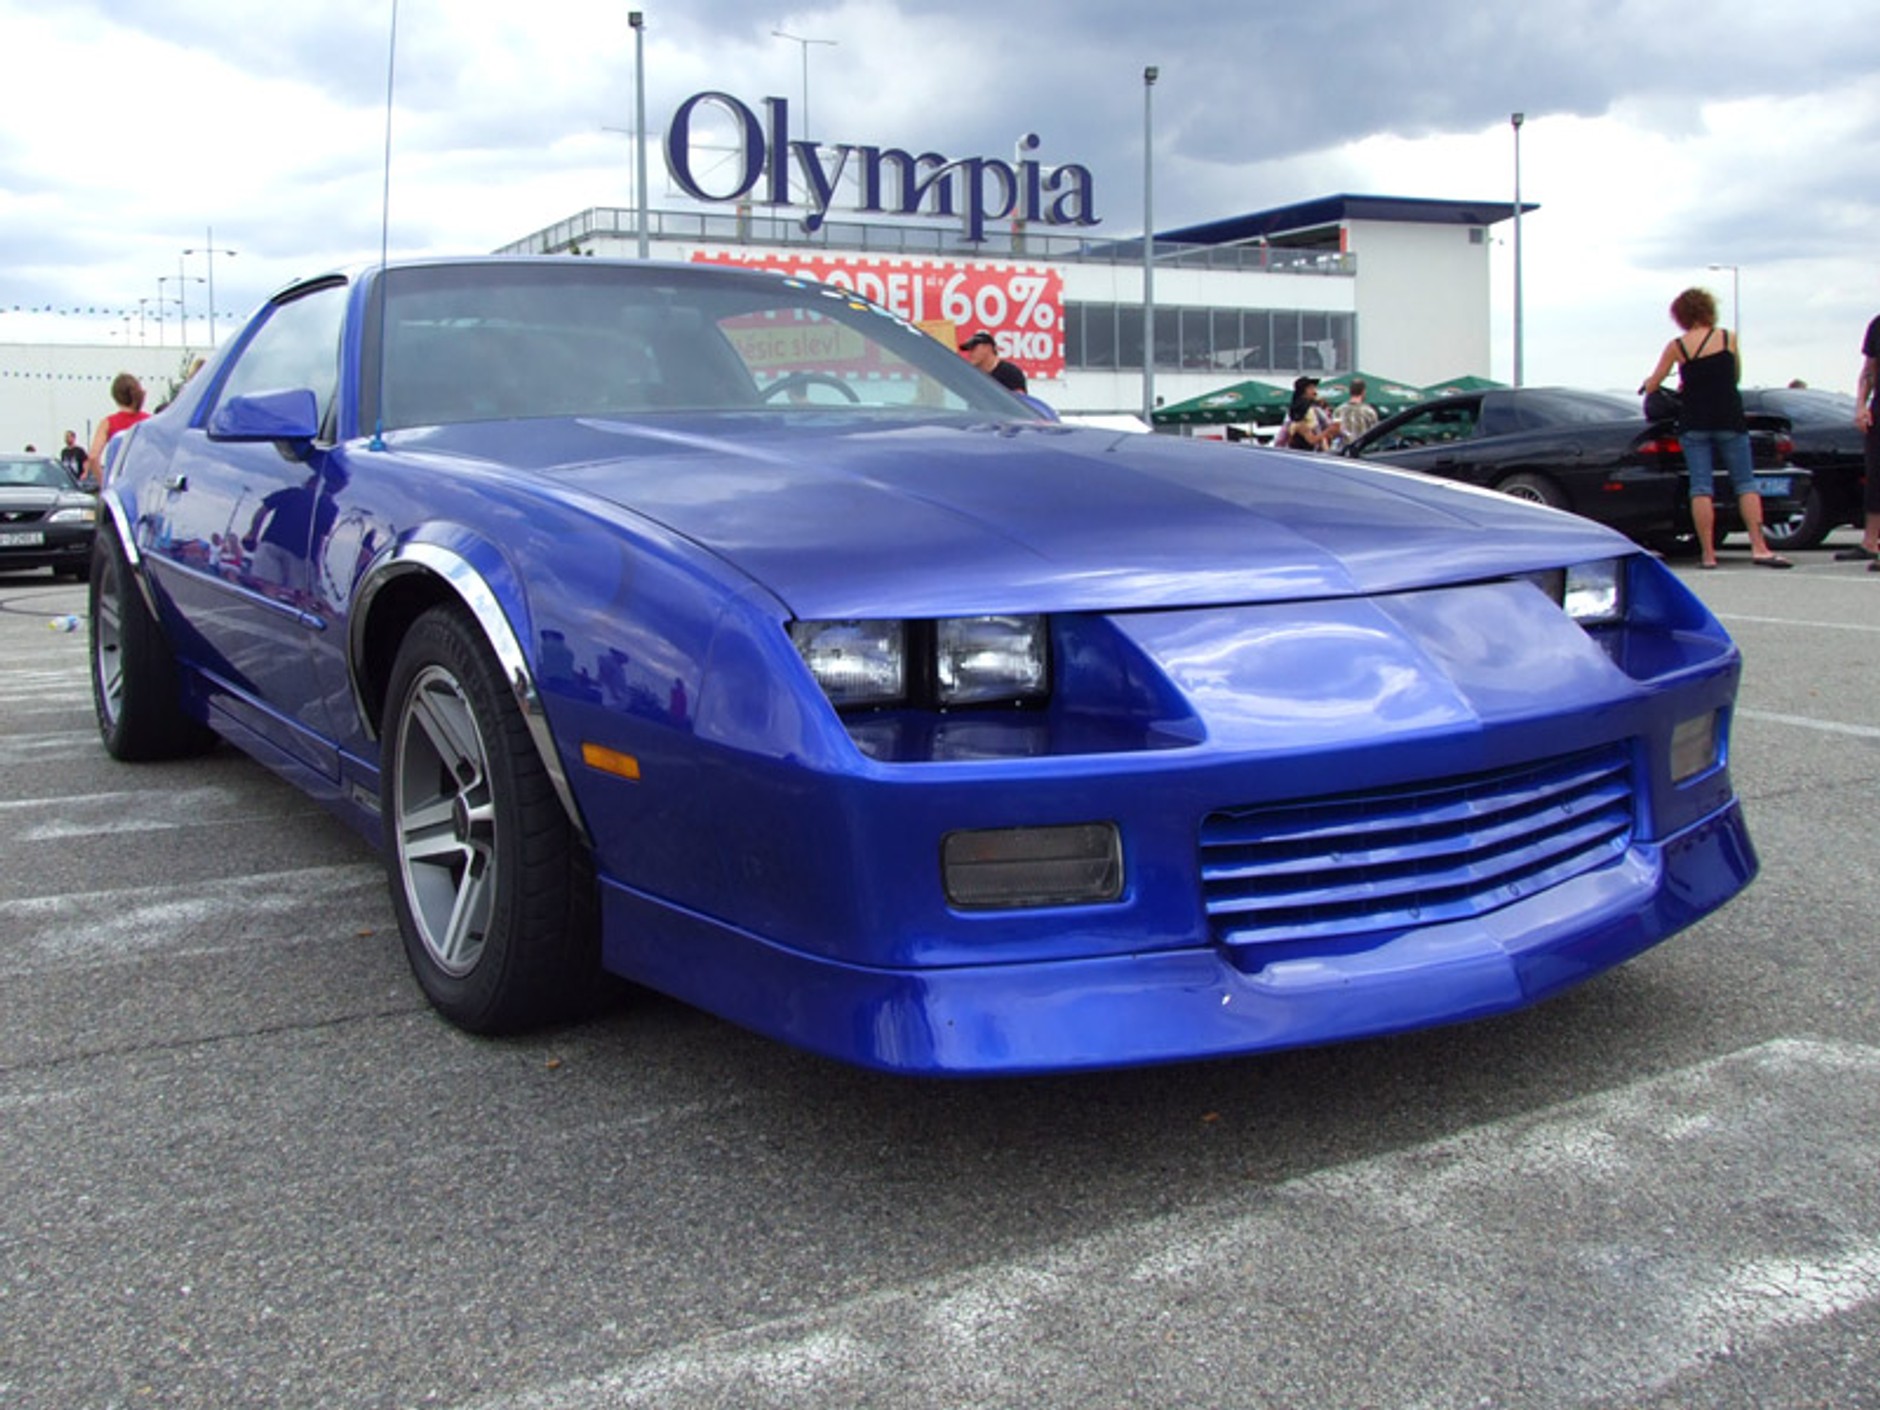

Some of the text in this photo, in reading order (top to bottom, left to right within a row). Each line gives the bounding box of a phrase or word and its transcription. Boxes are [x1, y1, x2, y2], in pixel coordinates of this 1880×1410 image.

[663, 90, 1102, 243] Olympia
[941, 272, 1055, 329] 60%
[976, 329, 1054, 360] SKO
